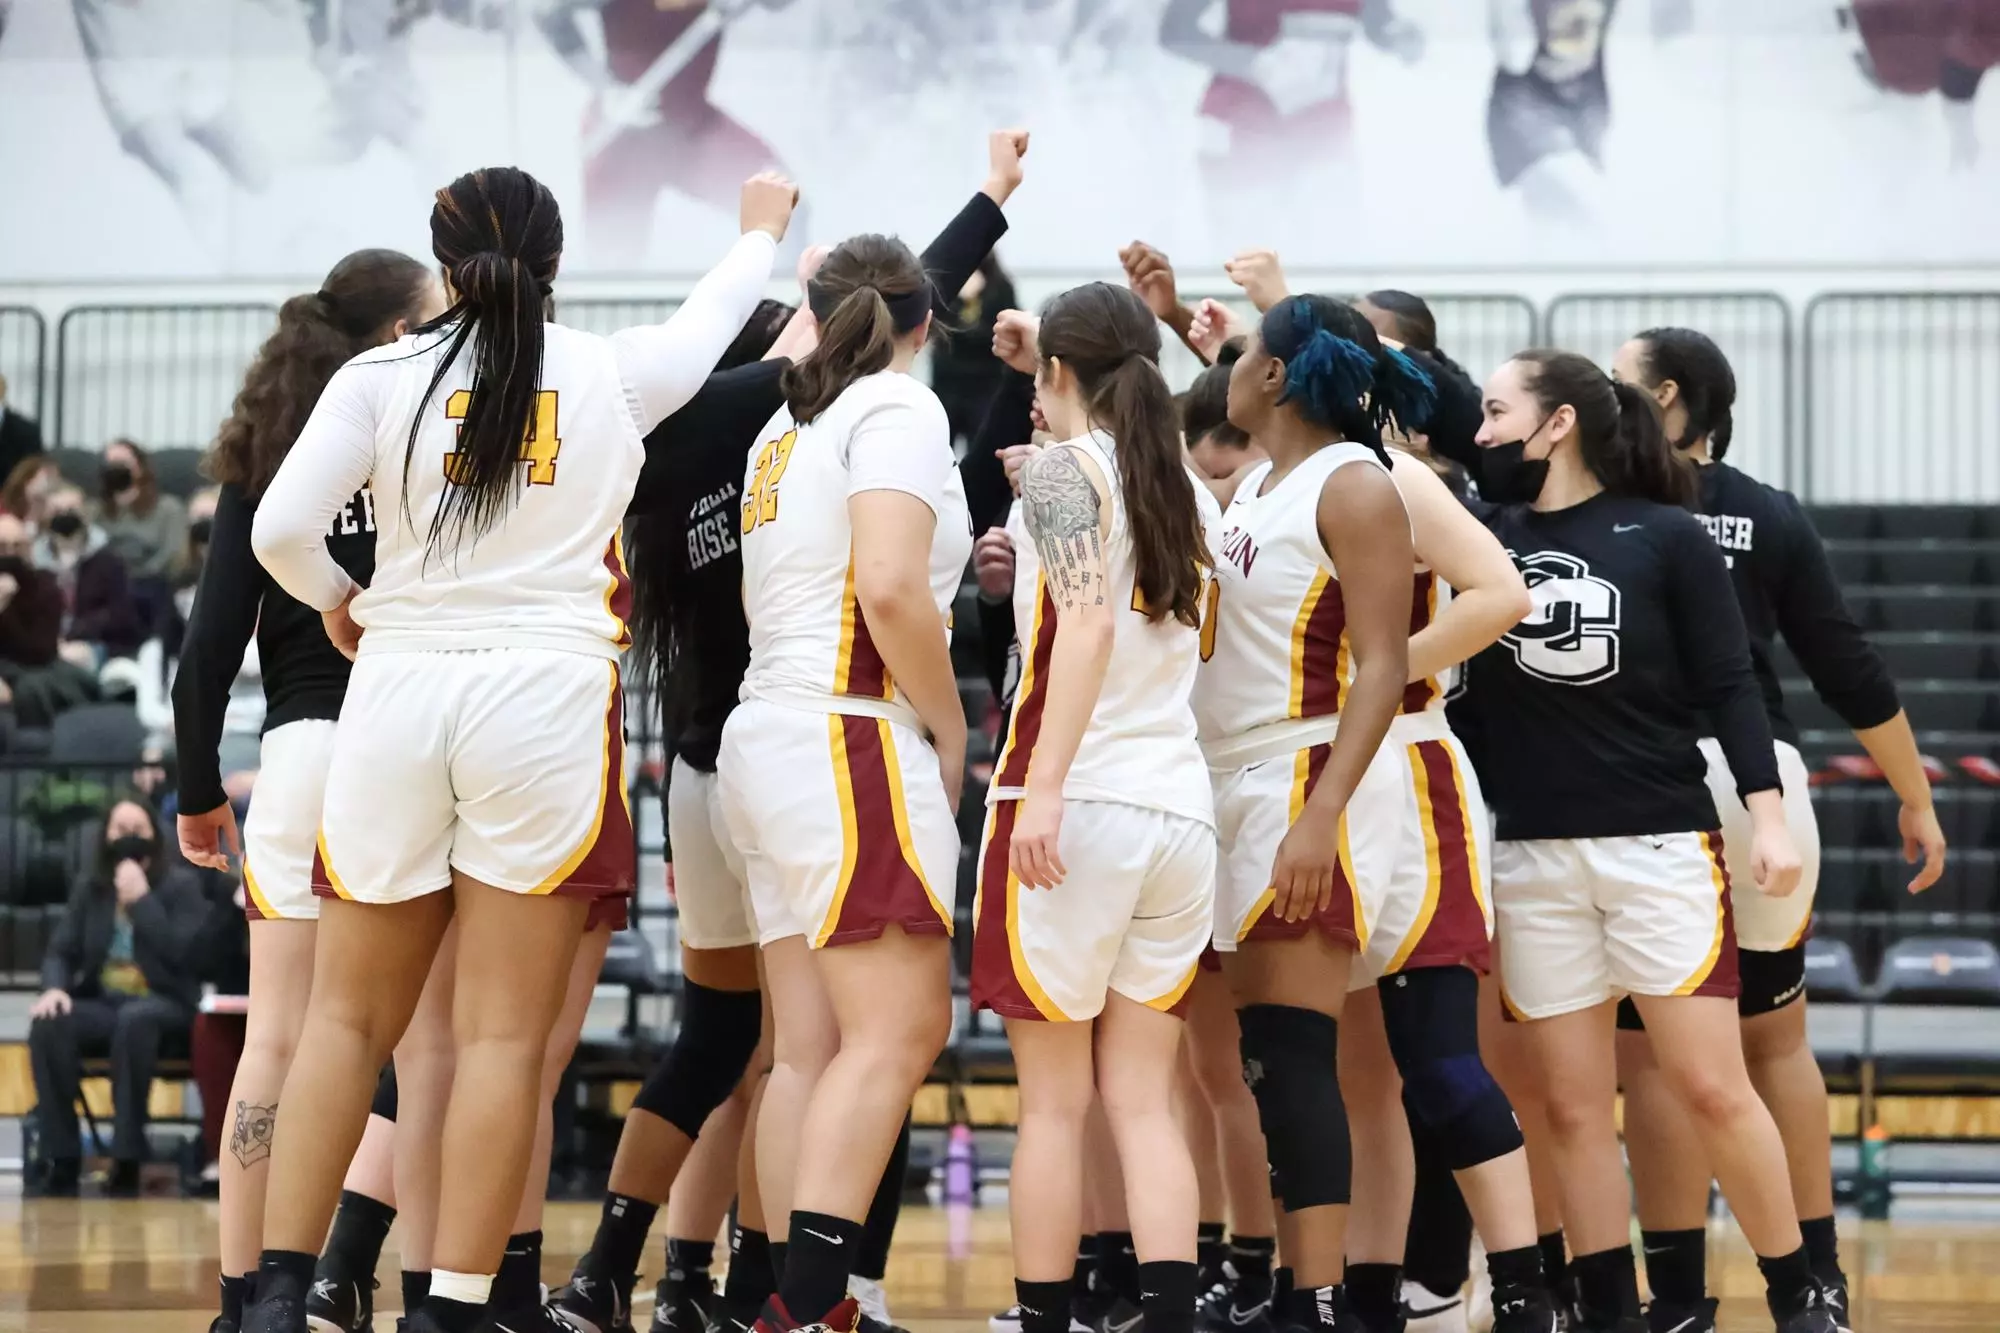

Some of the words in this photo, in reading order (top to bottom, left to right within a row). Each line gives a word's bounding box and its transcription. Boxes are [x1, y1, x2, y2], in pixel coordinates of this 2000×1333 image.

[742, 428, 798, 535] 32
[687, 511, 738, 571] RISE
[1693, 514, 1754, 551] HER
